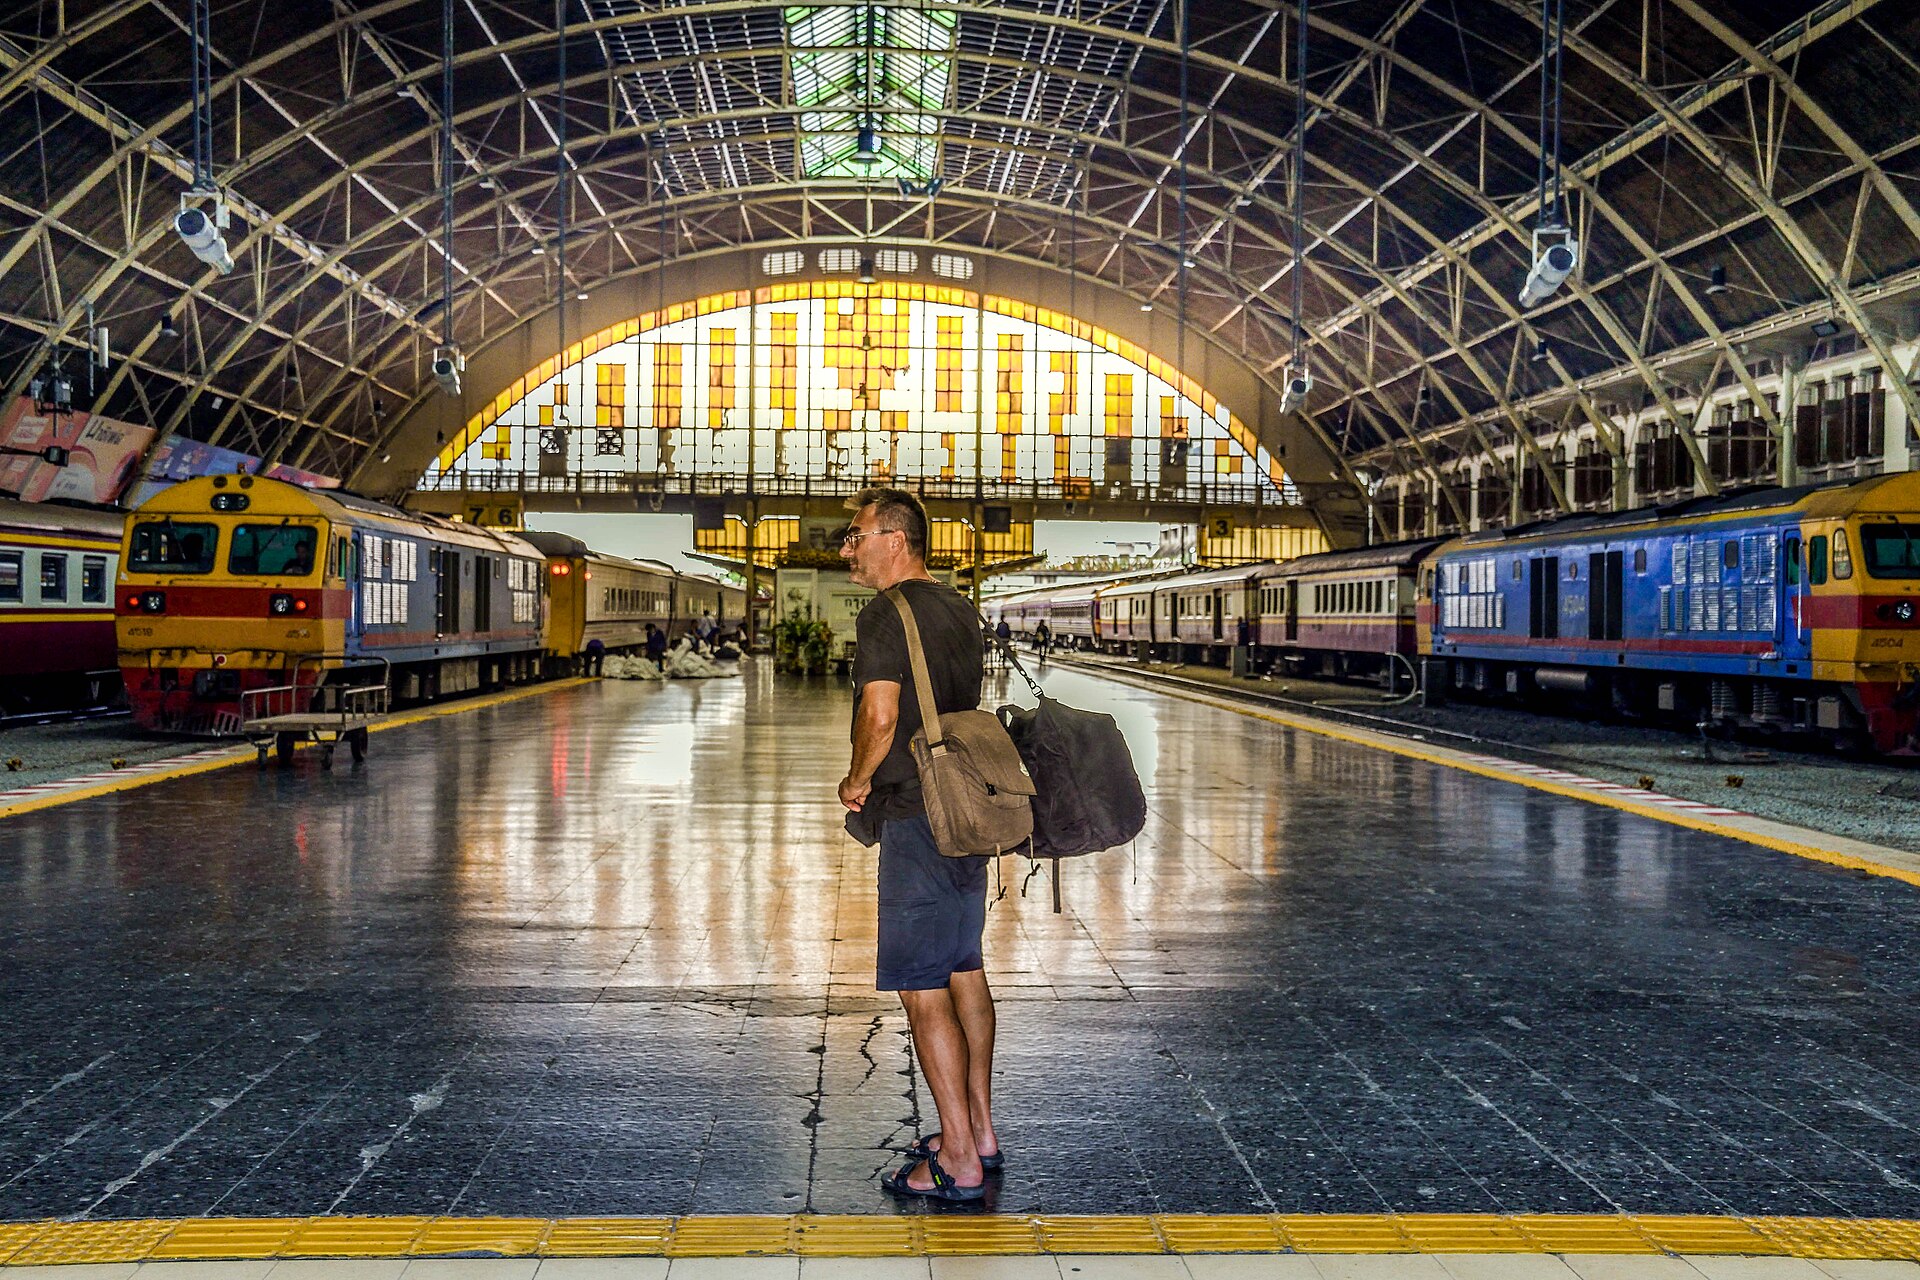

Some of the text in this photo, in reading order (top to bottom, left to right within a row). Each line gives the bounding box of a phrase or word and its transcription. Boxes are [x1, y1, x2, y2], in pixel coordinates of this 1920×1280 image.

[469, 507, 484, 526] 7
[498, 508, 513, 525] 6
[1215, 520, 1228, 535] 3
[1870, 637, 1904, 648] 4504
